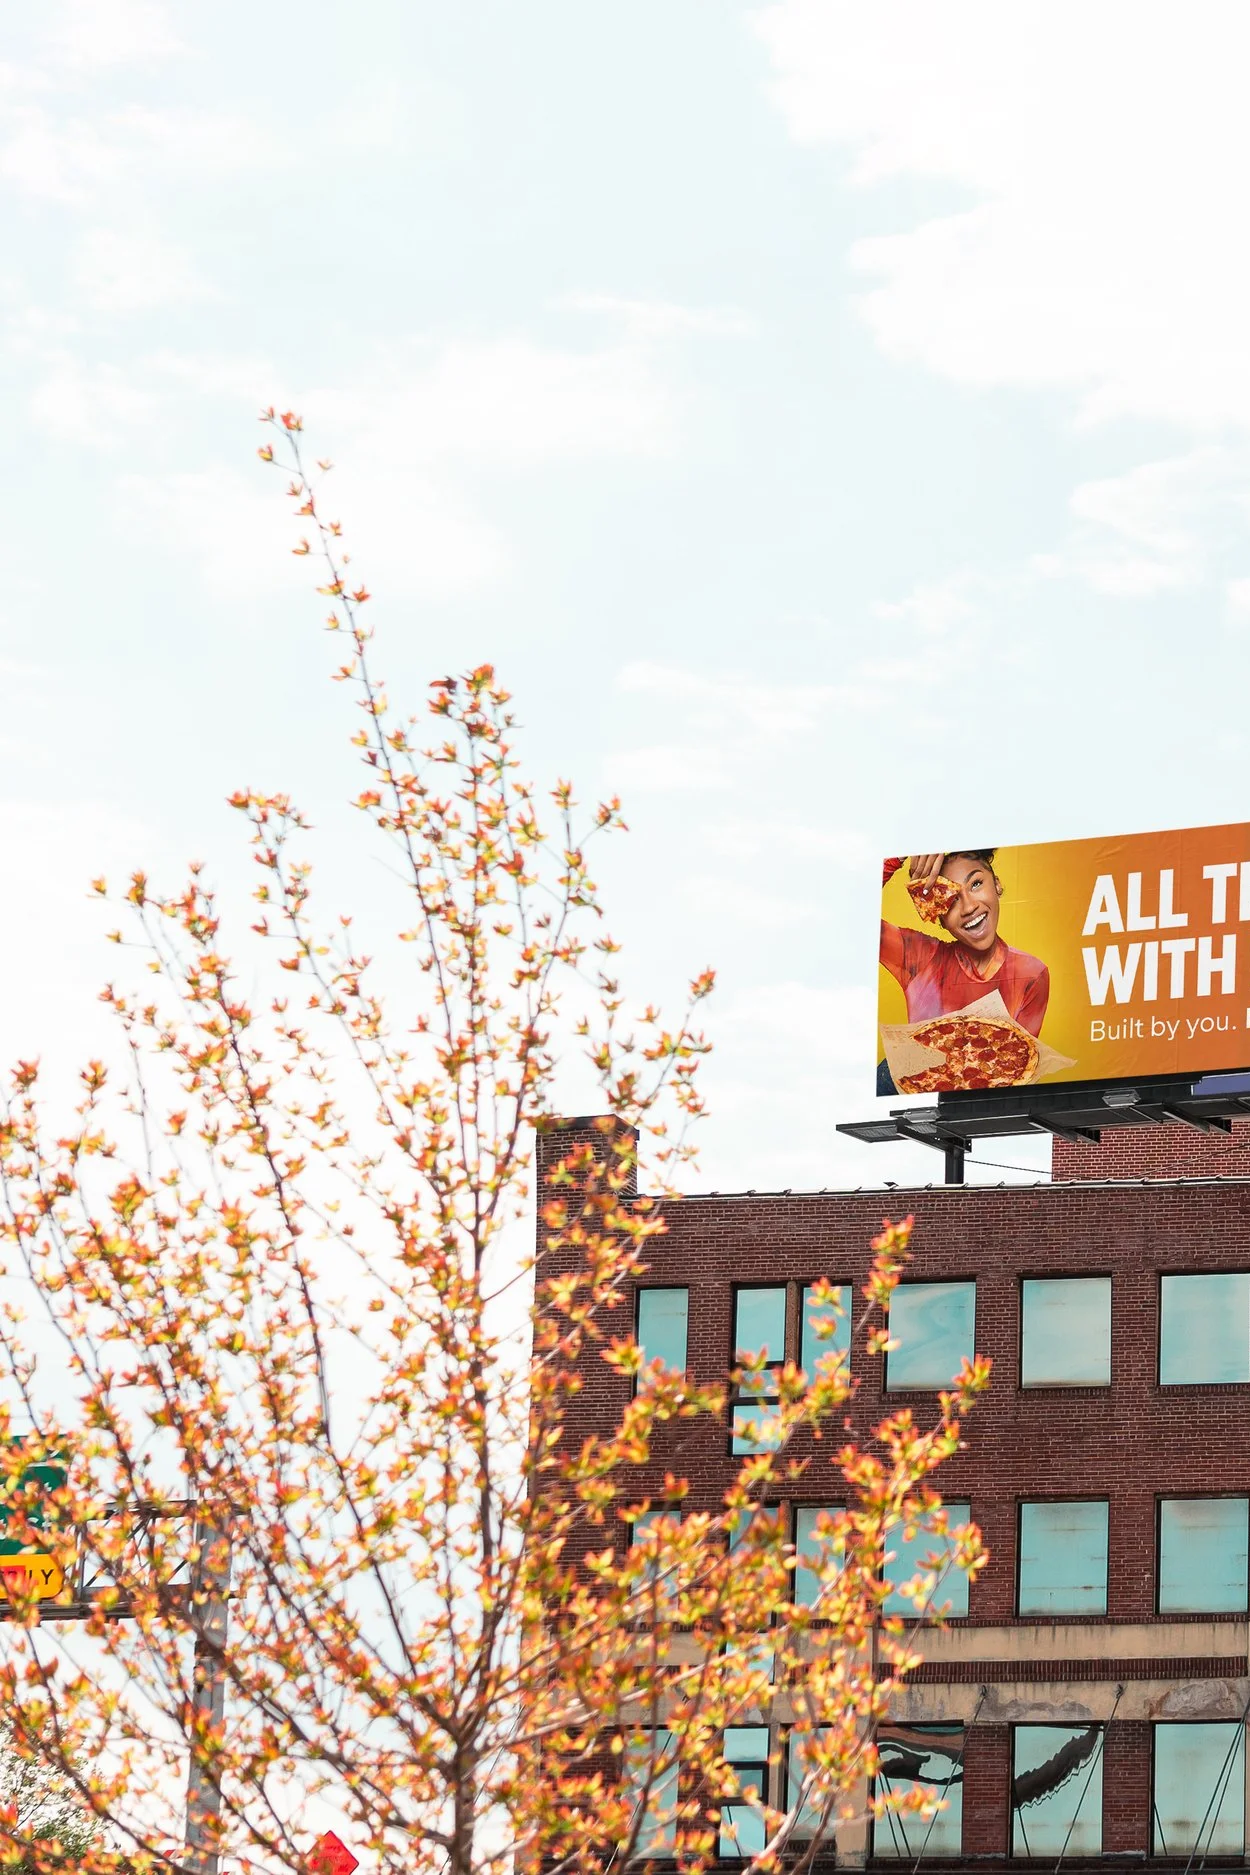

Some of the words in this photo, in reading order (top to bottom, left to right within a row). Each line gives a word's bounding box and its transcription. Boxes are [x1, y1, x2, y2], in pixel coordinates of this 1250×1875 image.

[1083, 869, 1189, 935] ALL
[1082, 934, 1237, 1005] WITH
[1090, 1016, 1144, 1042] Built
[1151, 1014, 1180, 1041] by
[1186, 1014, 1238, 1039] you.
